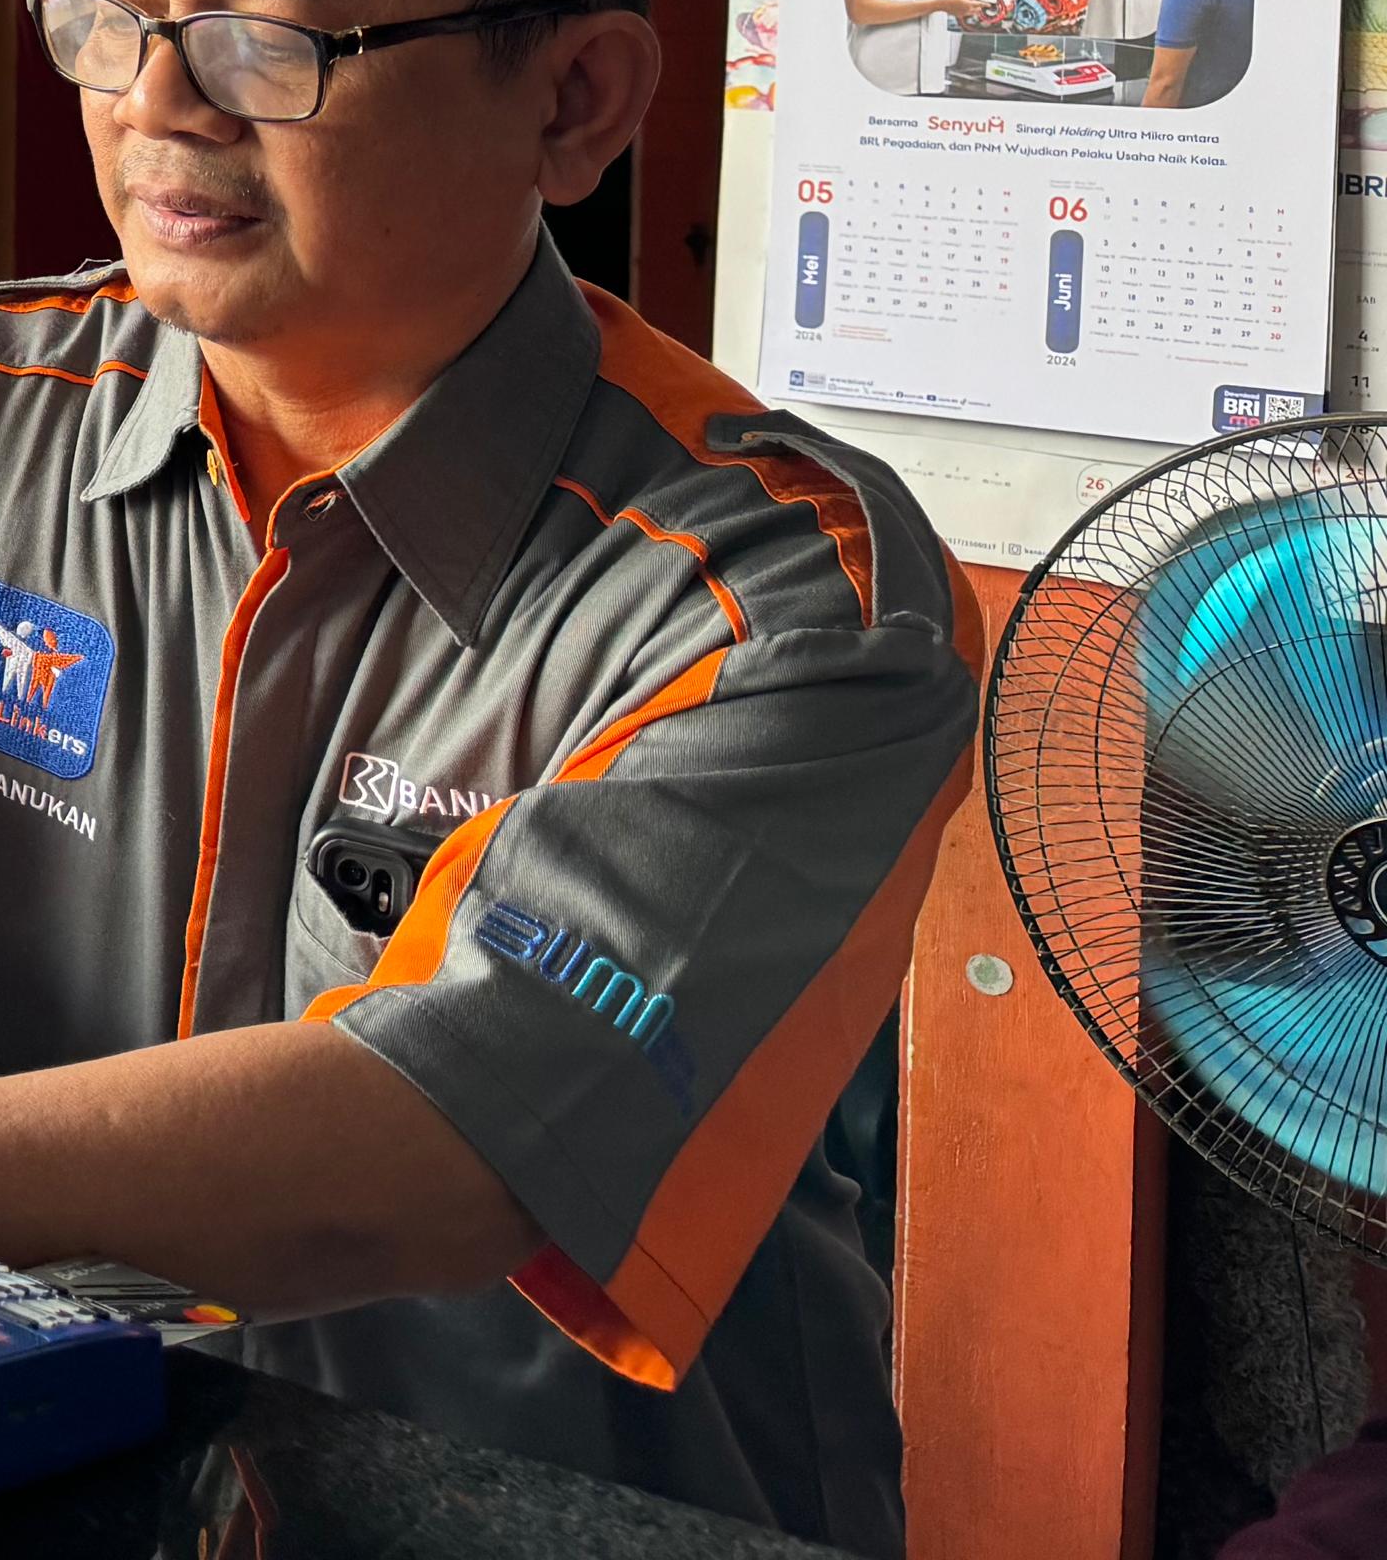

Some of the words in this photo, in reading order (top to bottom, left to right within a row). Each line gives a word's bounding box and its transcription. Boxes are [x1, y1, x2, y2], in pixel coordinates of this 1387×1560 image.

[868, 116, 918, 128] Bersama
[1016, 123, 1056, 137] Sinergi
[1059, 125, 1106, 140] Holding
[1109, 128, 1137, 140] Ultra
[1141, 131, 1174, 142] Mikro
[1178, 133, 1220, 144] antara
[949, 141, 972, 152] dan
[975, 142, 1001, 153] PNM
[1004, 143, 1068, 158] Wujudkan
[1071, 147, 1113, 161] Pelaku
[1116, 150, 1155, 163] Usaha
[1159, 152, 1187, 164] Naik
[798, 179, 833, 204] 05
[1049, 196, 1088, 222] 06
[801, 255, 819, 285] Mei
[1054, 273, 1072, 311] Juni
[1359, 330, 1368, 342] 4
[1046, 354, 1077, 368] 2024
[1351, 376, 1370, 388] 11
[1223, 398, 1260, 416] BRI
[1086, 477, 1105, 490] 26
